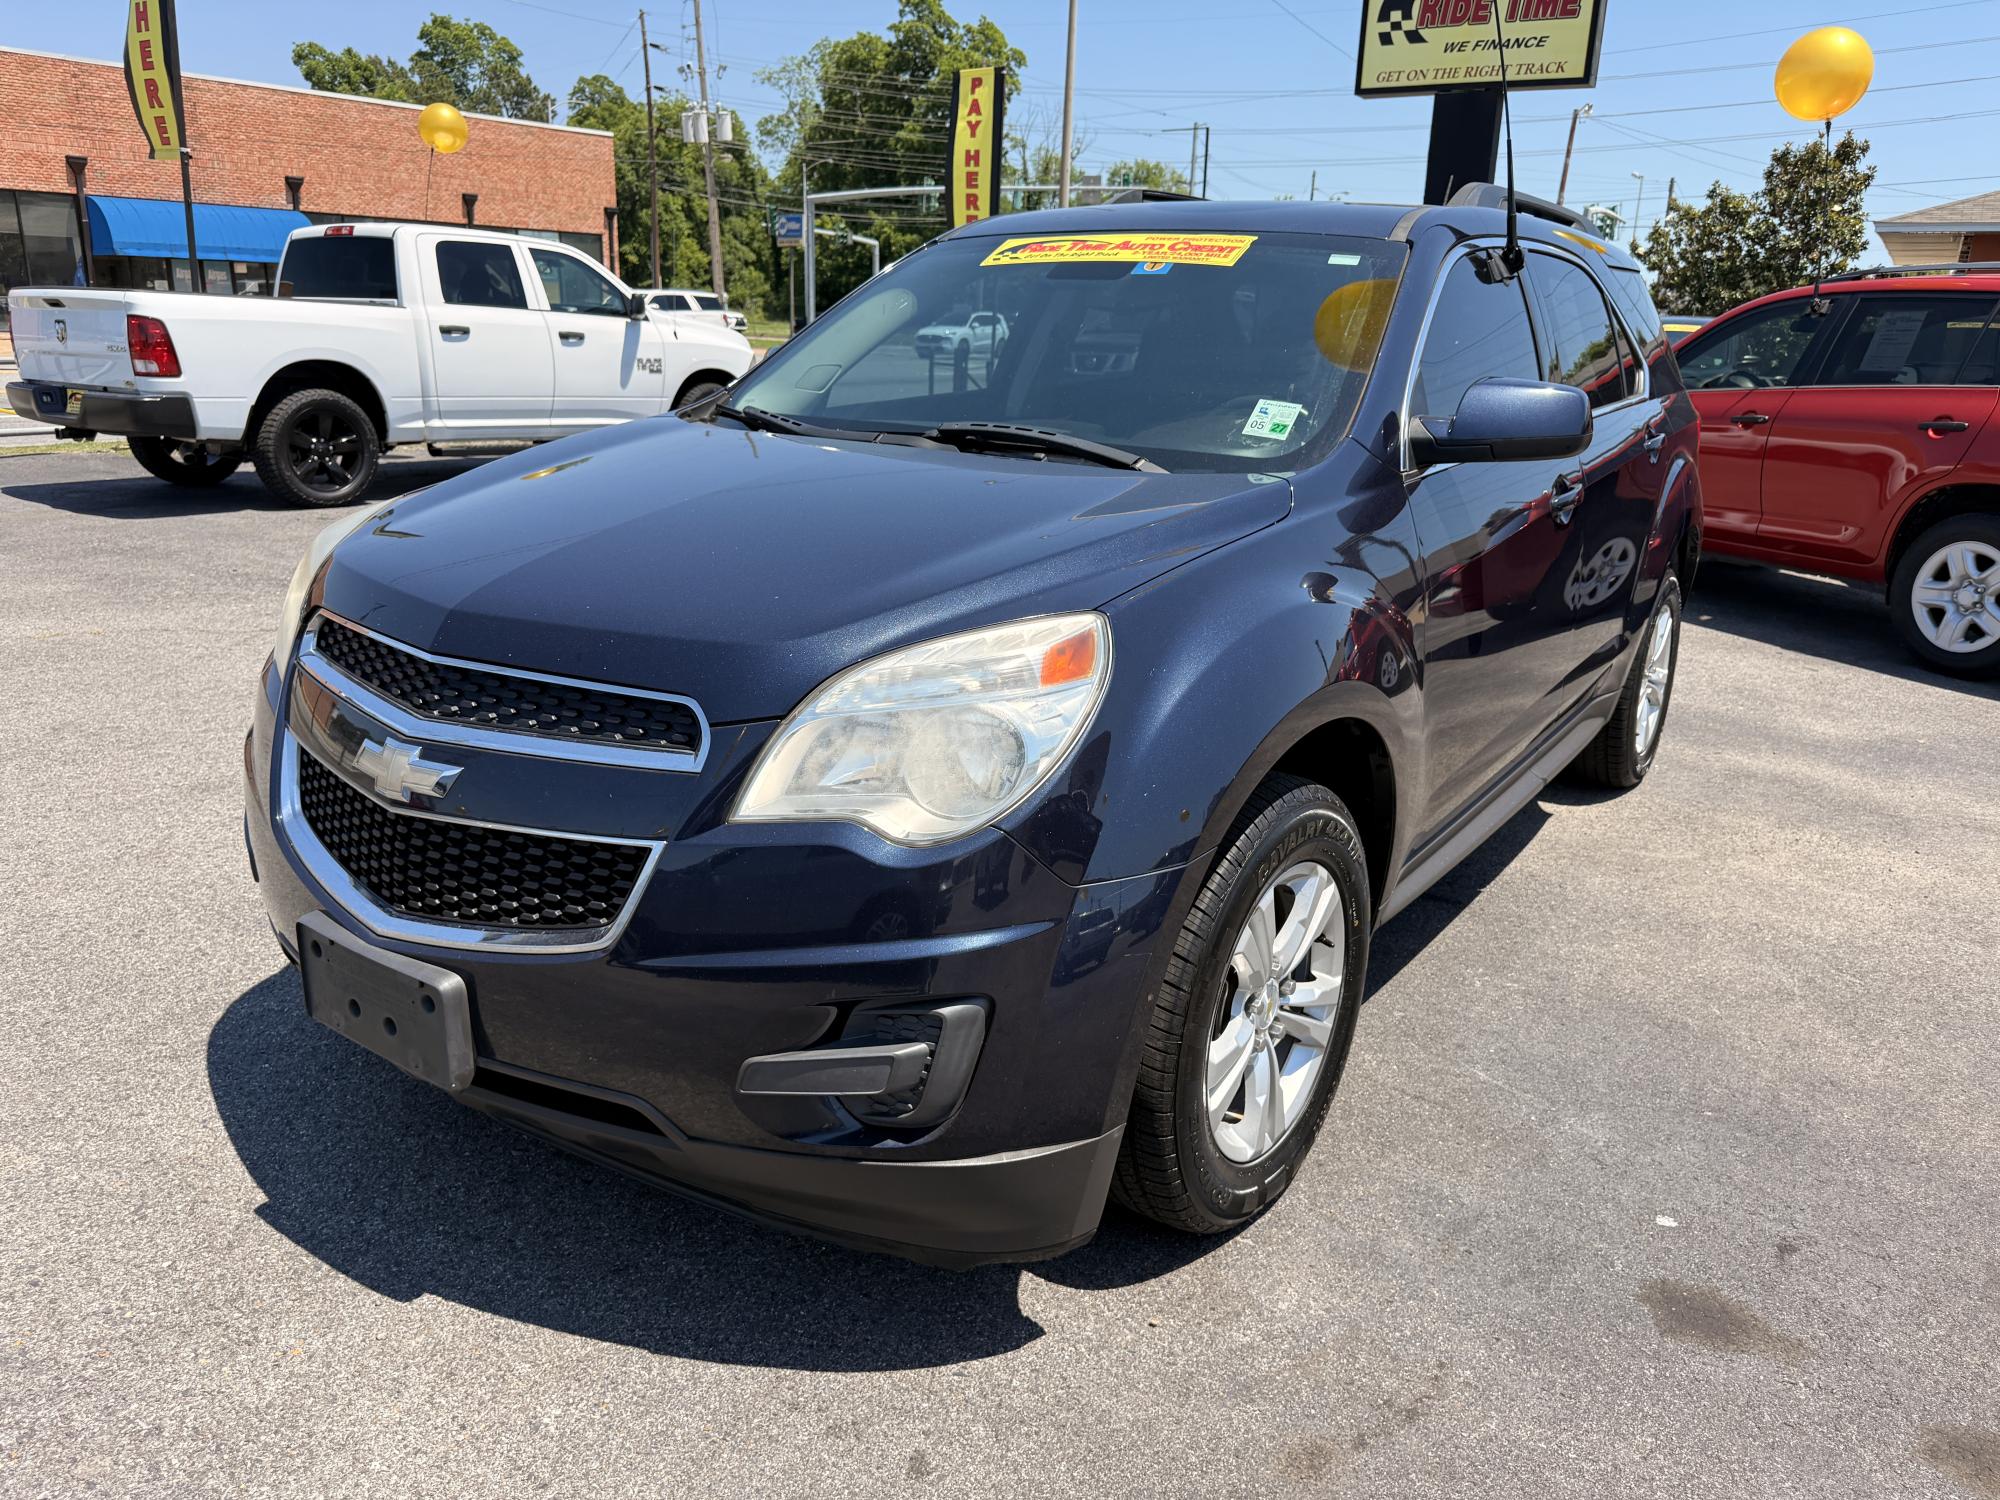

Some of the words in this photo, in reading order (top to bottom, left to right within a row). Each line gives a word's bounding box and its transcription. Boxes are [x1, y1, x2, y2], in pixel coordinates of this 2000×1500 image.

[1416, 0, 1492, 29] RIDE
[1443, 40, 1468, 53] WE
[1472, 35, 1550, 51] FINANCE
[134, 1, 172, 146] HERE
[1376, 70, 1405, 83] GET
[1406, 69, 1432, 82] ON
[1433, 67, 1461, 80] THE
[1463, 64, 1514, 78] RIGHT
[1515, 61, 1569, 75] TRACK
[966, 77, 983, 138] PAY
[1250, 419, 1266, 430] 05
[1270, 422, 1288, 433] 27
[1258, 818, 1325, 887] CAVALRY
